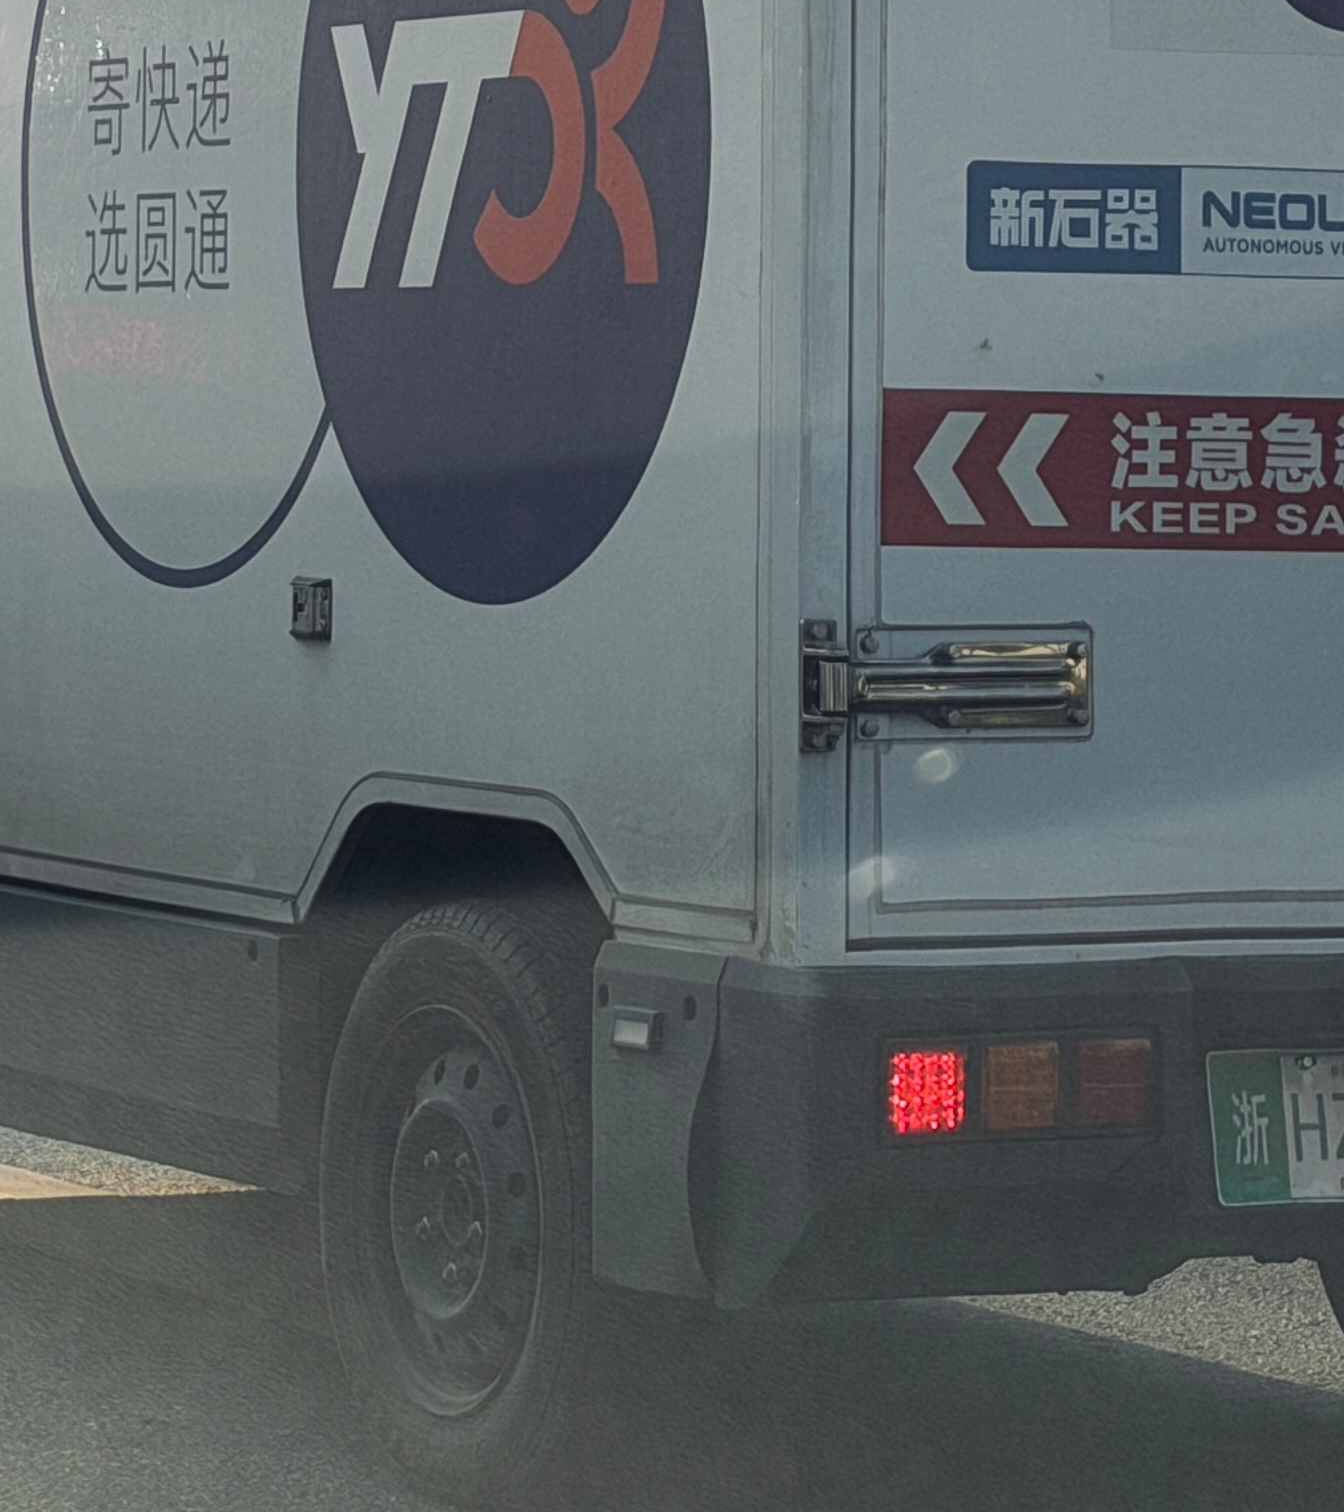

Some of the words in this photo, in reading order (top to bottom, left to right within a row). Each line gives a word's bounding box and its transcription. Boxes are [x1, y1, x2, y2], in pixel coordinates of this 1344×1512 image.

[86, 38, 232, 156] 寄快递
[84, 189, 231, 294] 选圆通
[989, 186, 1159, 252] 新石器
[1202, 236, 1324, 256] AUTONOMOUS
[1110, 500, 1257, 535] KEEP
